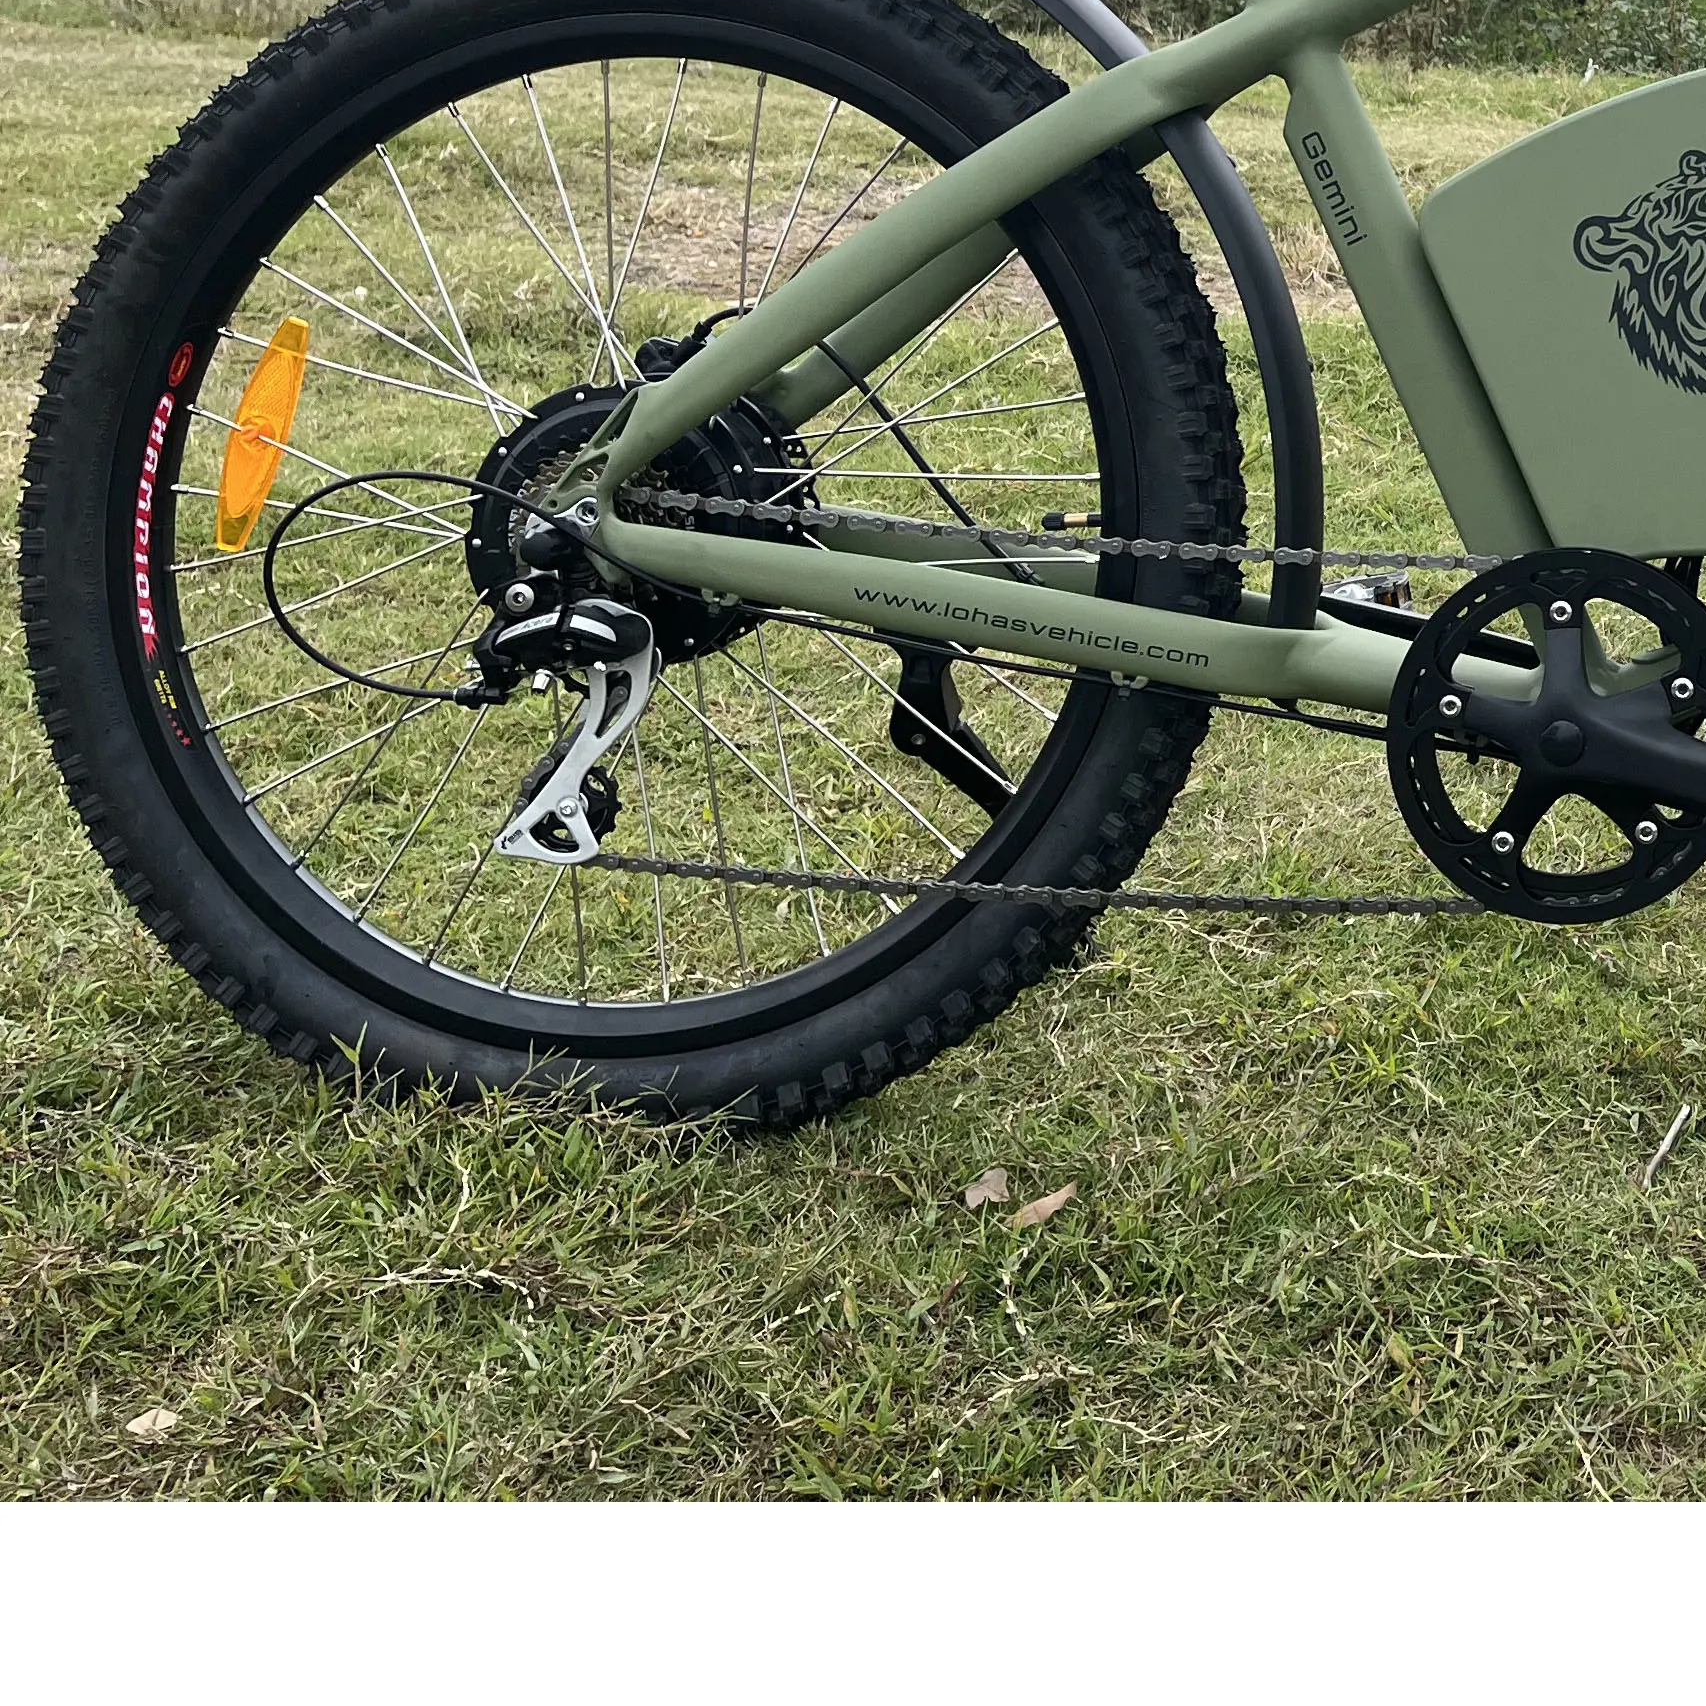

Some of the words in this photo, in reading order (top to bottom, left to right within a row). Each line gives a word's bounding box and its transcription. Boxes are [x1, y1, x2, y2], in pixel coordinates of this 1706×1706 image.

[1302, 131, 1368, 247] Gemini
[135, 395, 173, 637] CHAMPION
[853, 586, 1210, 668] www.lohasvehicle.com
